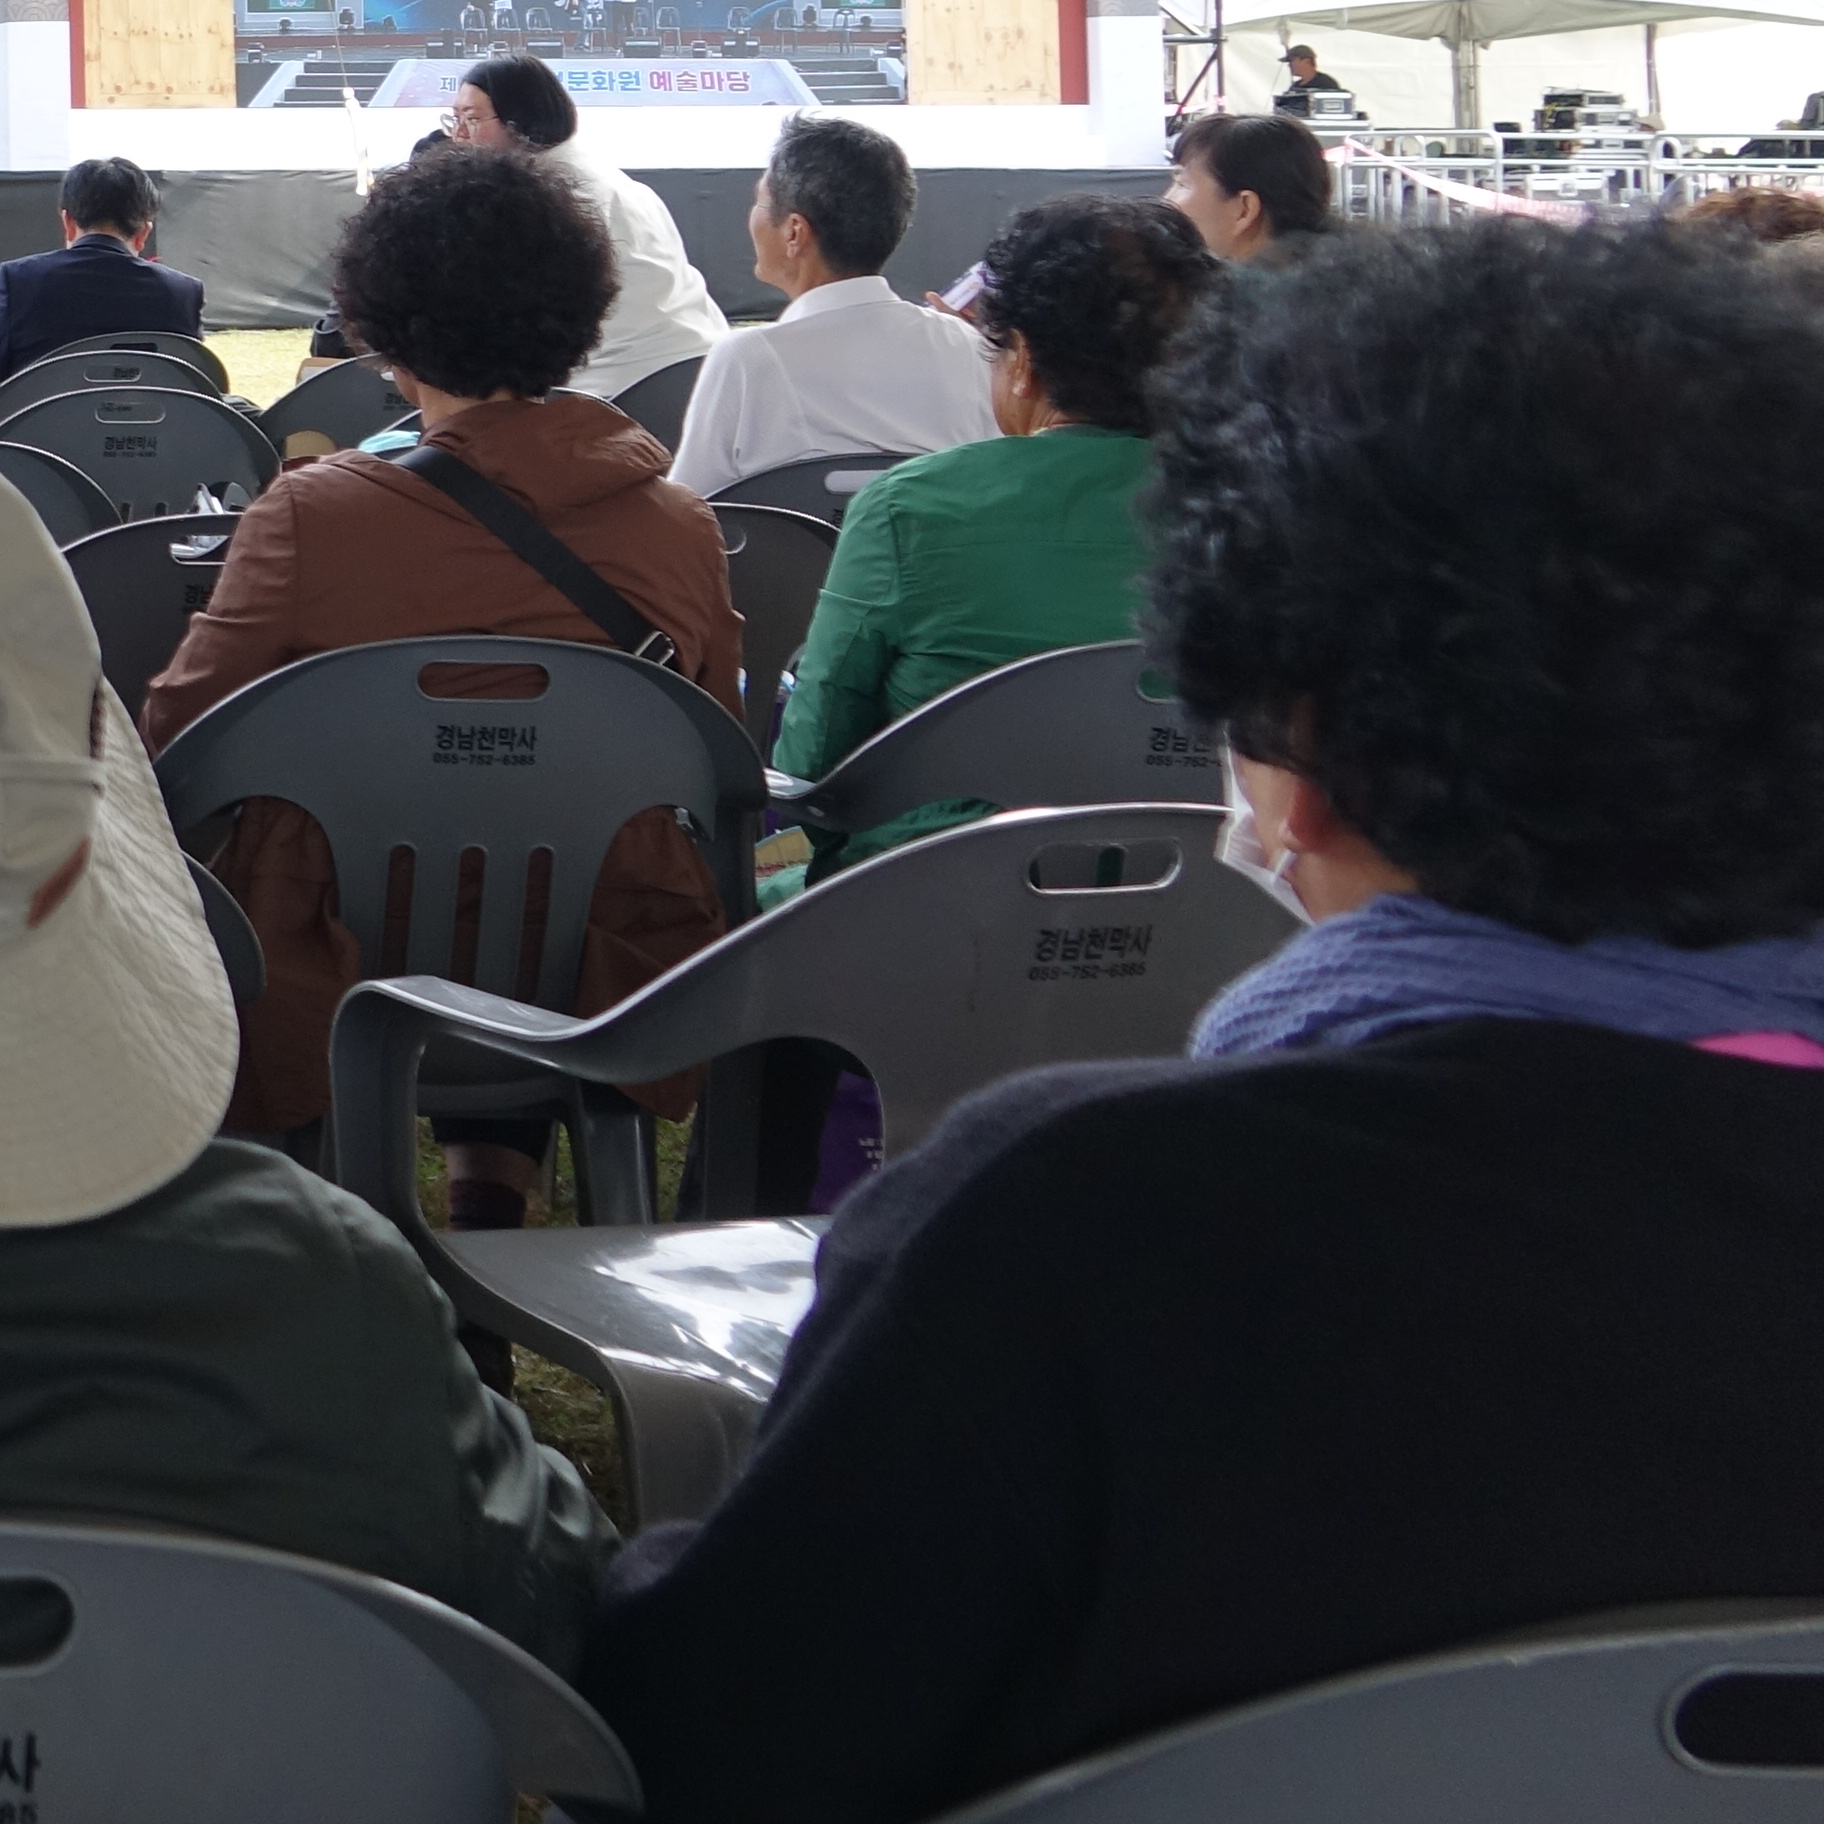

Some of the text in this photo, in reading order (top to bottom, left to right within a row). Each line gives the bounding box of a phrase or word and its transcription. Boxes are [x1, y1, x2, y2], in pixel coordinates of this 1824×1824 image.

[648, 69, 752, 93] 예술마당
[435, 723, 538, 752] 경남천막사
[432, 752, 537, 767] 055-752-6385
[1033, 922, 1153, 963] 경남천막사
